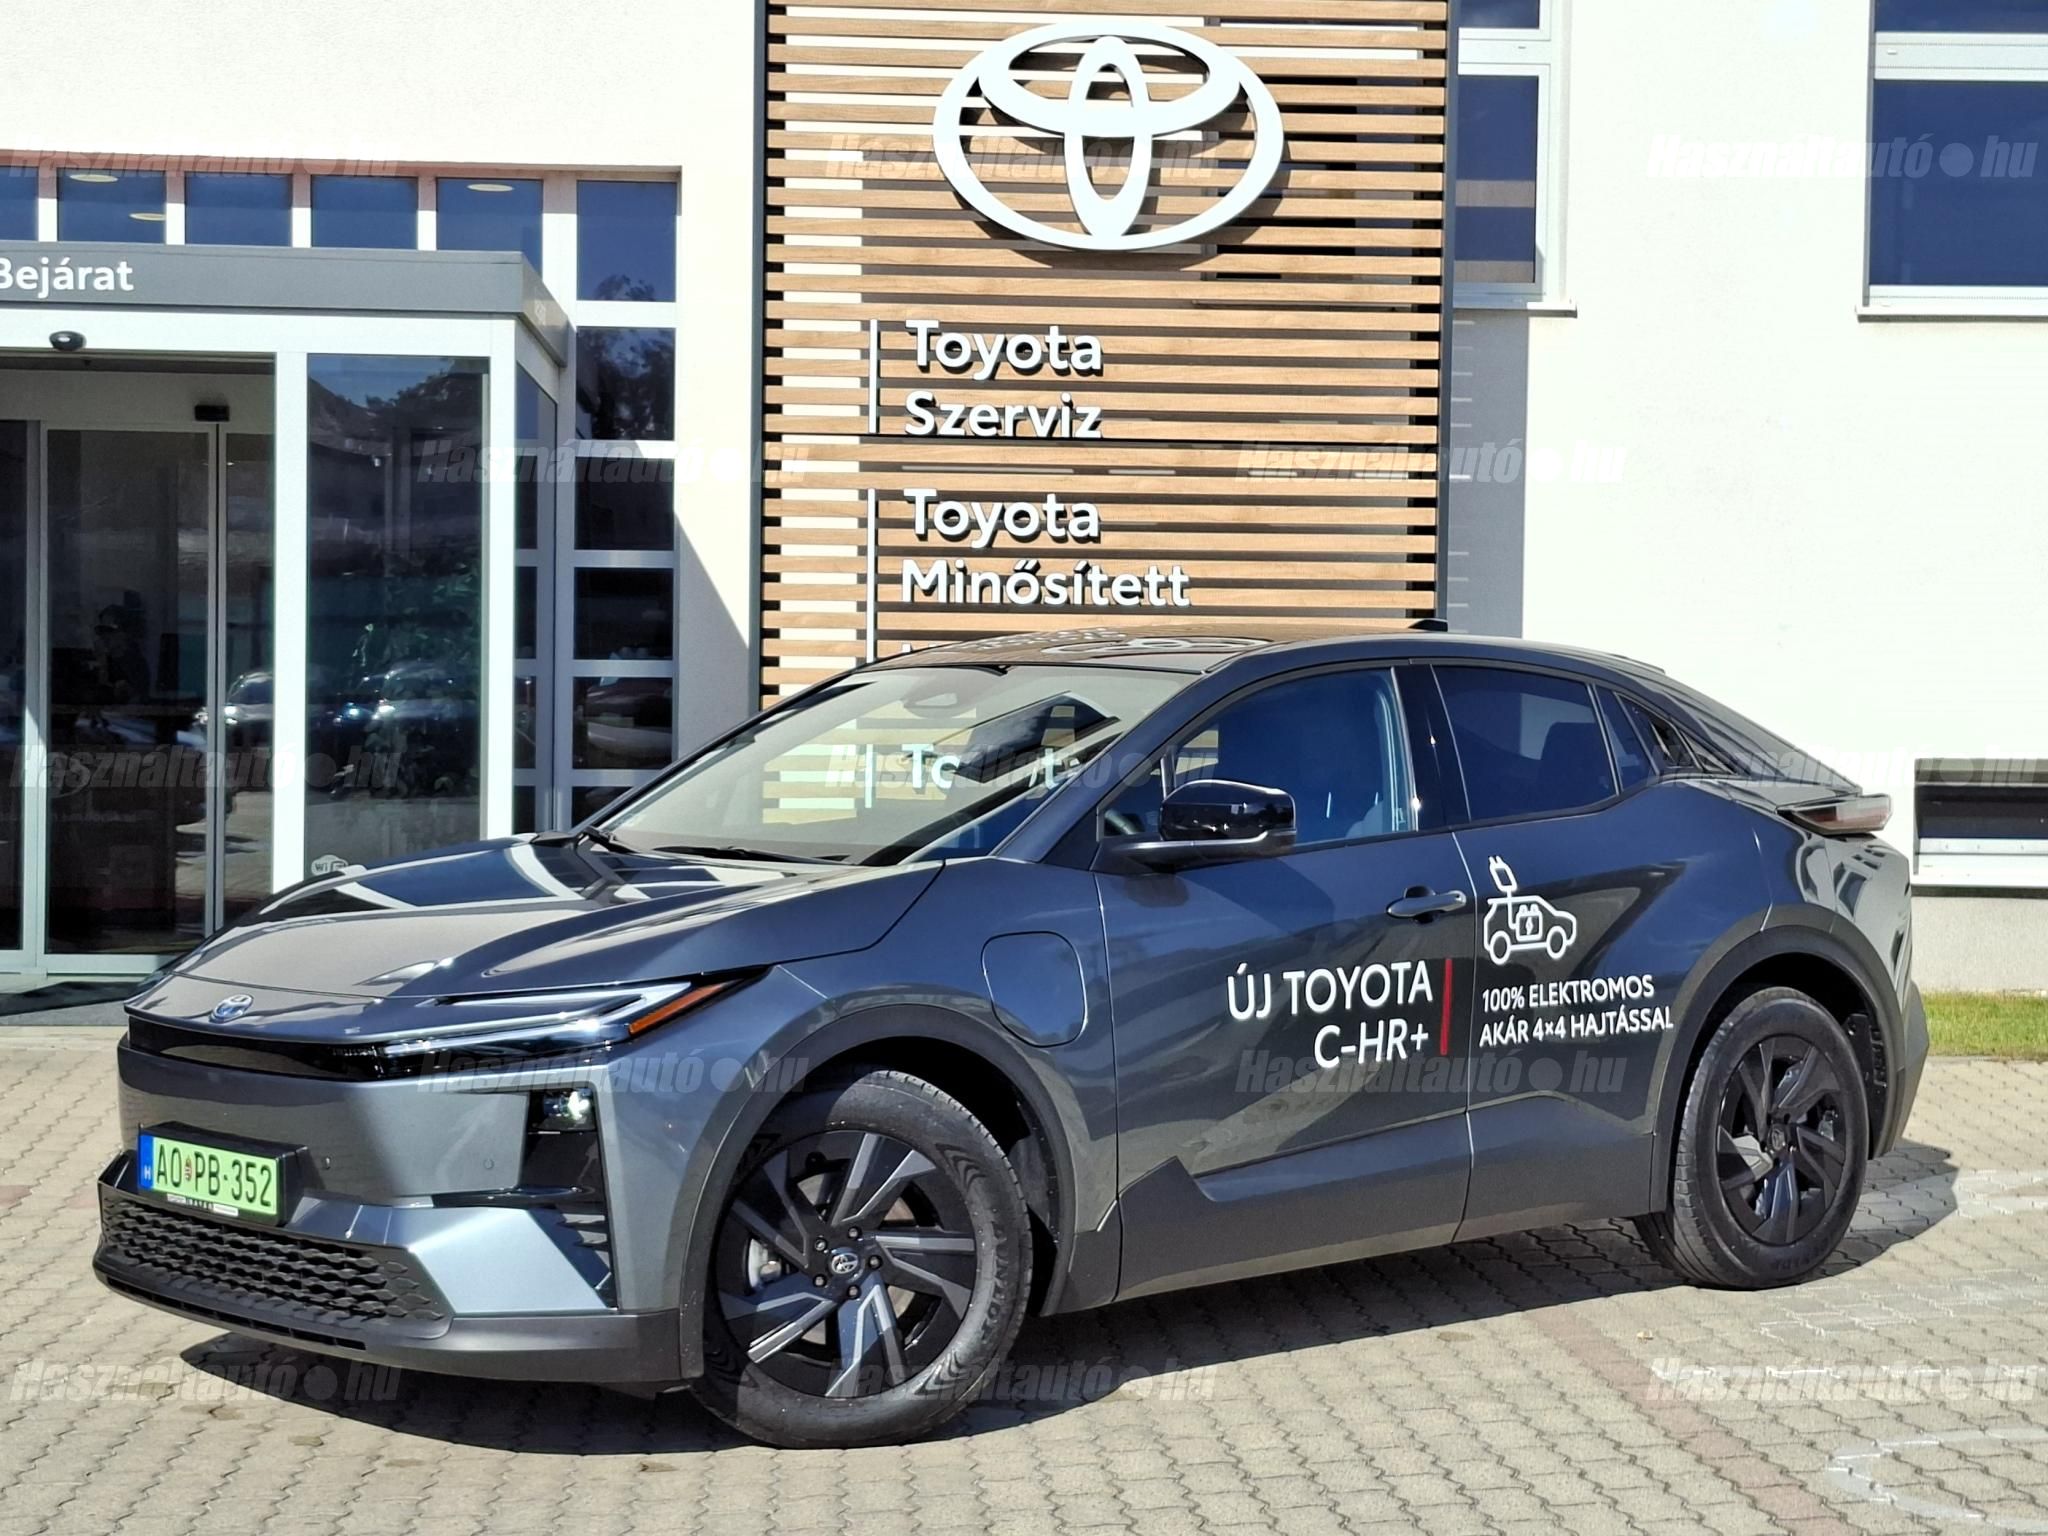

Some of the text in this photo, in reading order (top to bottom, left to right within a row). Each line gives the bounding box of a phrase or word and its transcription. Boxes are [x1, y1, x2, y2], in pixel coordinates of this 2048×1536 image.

[0, 257, 134, 298] Bejárat
[905, 319, 1102, 380] Toyota
[904, 390, 1102, 437] Szerviz
[903, 488, 1099, 549] Toyota
[901, 558, 1190, 607] Minősített
[1227, 960, 1433, 1020] ÚJ TOYOTA
[1482, 974, 1655, 1013] 100% ELEKTROMOS
[1314, 1018, 1429, 1069] C-HR+
[1479, 1015, 1529, 1048] AKÁR
[1570, 1004, 1674, 1039] HAJTÁSSAL
